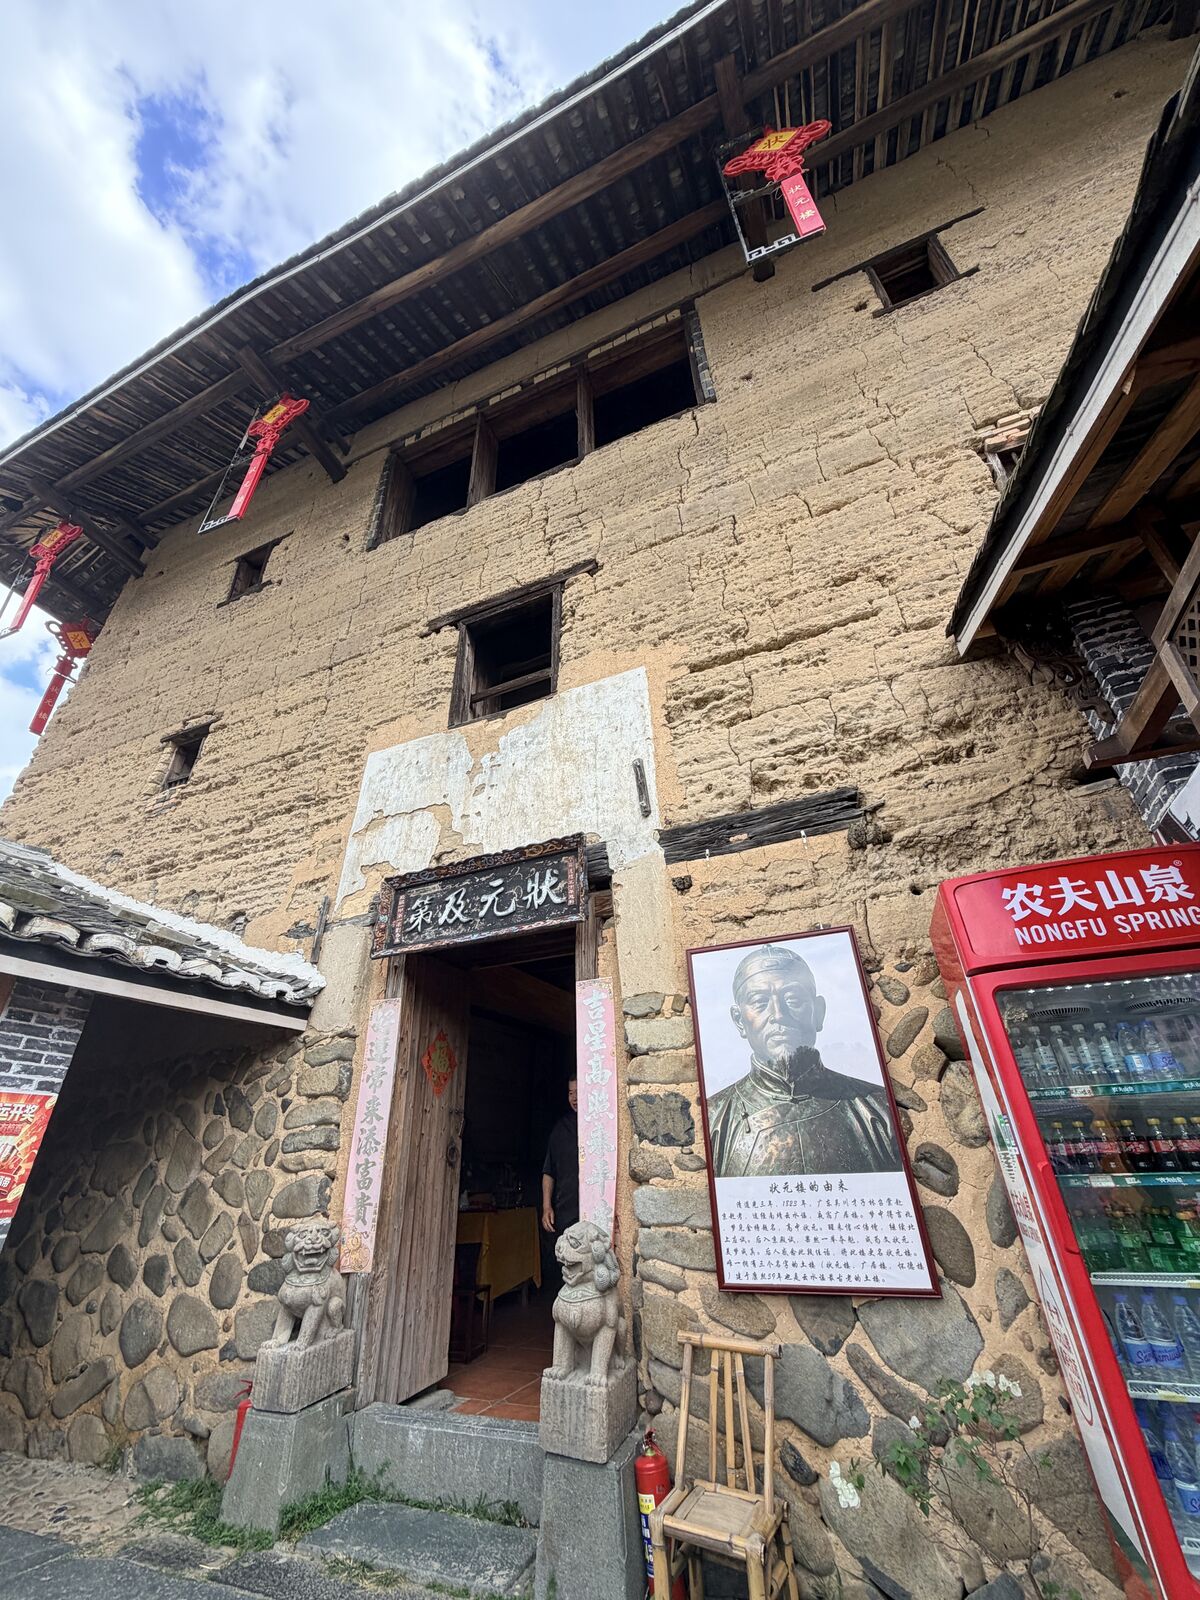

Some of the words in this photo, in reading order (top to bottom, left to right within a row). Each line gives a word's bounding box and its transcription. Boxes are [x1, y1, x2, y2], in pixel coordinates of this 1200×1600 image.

[763, 135, 787, 149] 状
[787, 185, 816, 221] 状元楼
[1001, 864, 1195, 922] 农夫山泉
[1013, 917, 1108, 946] NONGFU
[769, 1179, 849, 1194] 状元楼的由来
